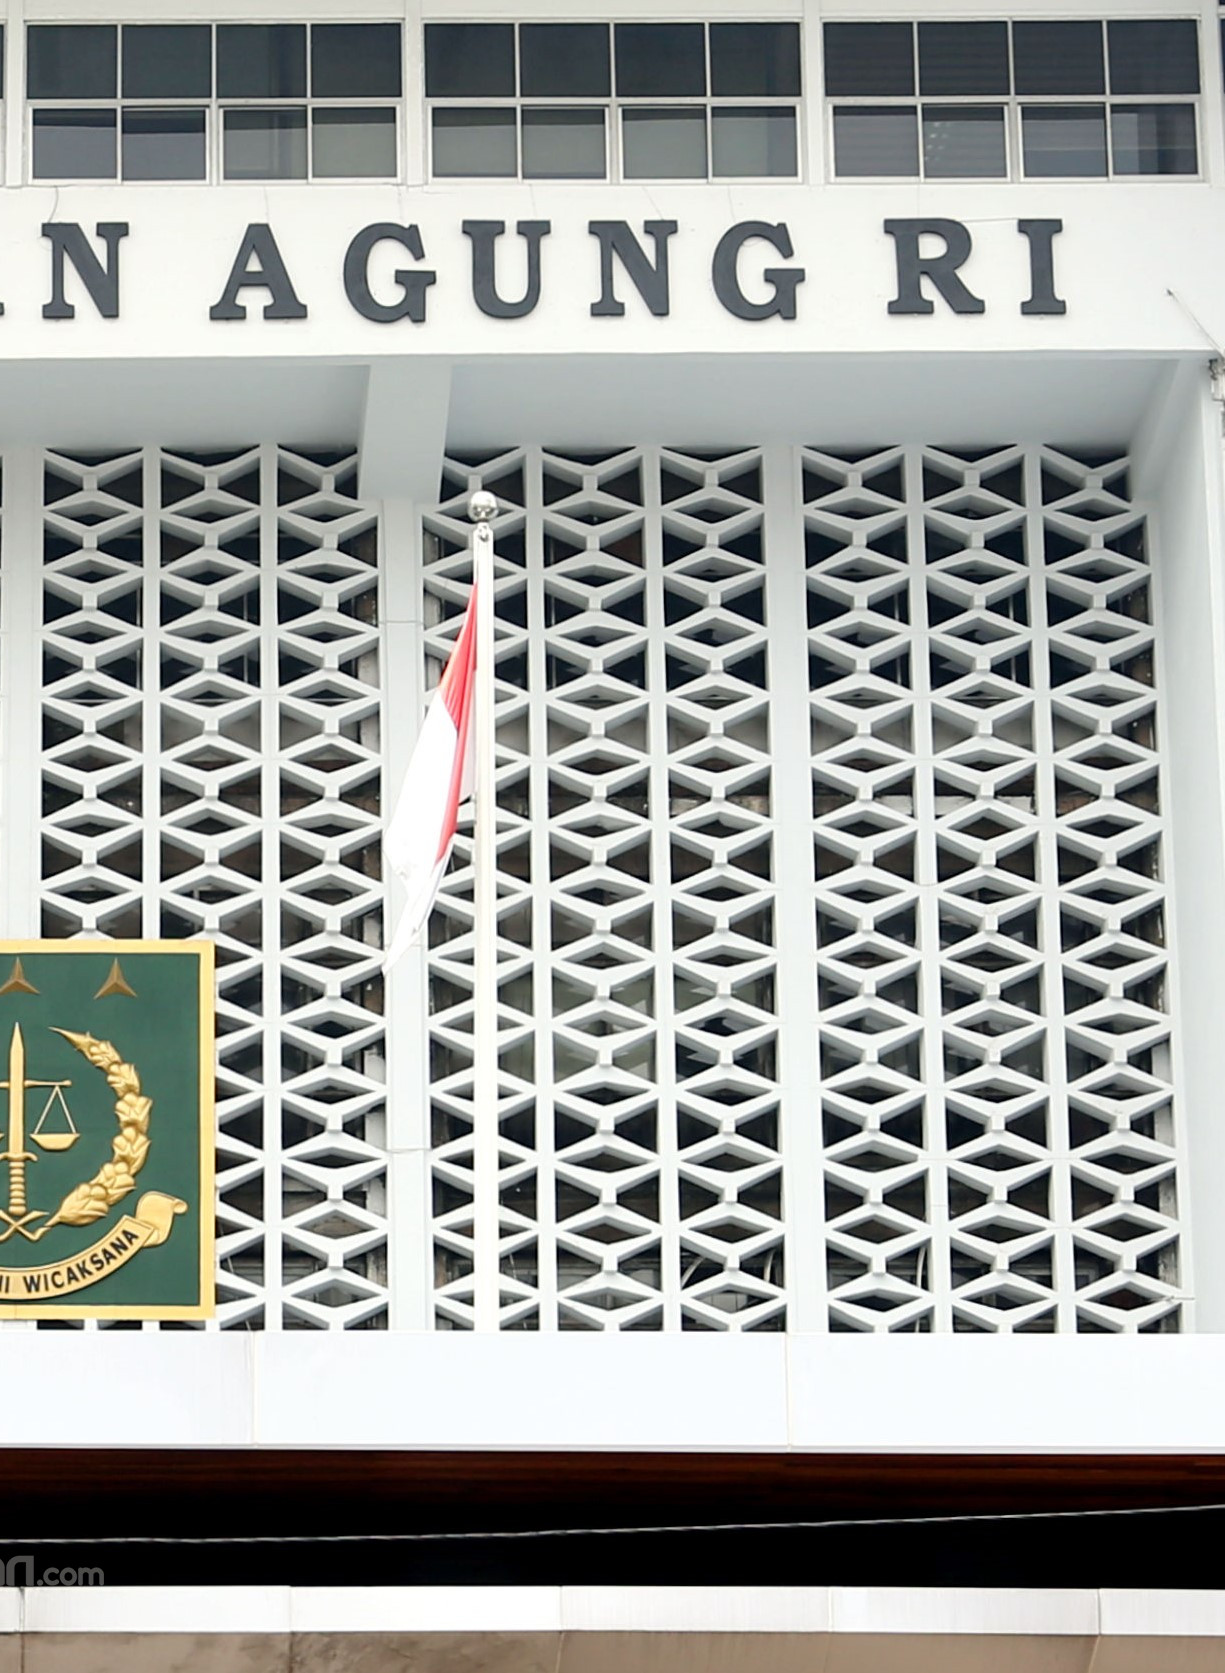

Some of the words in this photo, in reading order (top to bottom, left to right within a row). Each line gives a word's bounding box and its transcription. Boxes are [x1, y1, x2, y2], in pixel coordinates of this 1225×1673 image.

[209, 219, 806, 324] AGUNG
[883, 218, 1067, 316] RI
[24, 1228, 139, 1294] WICAKSANA
